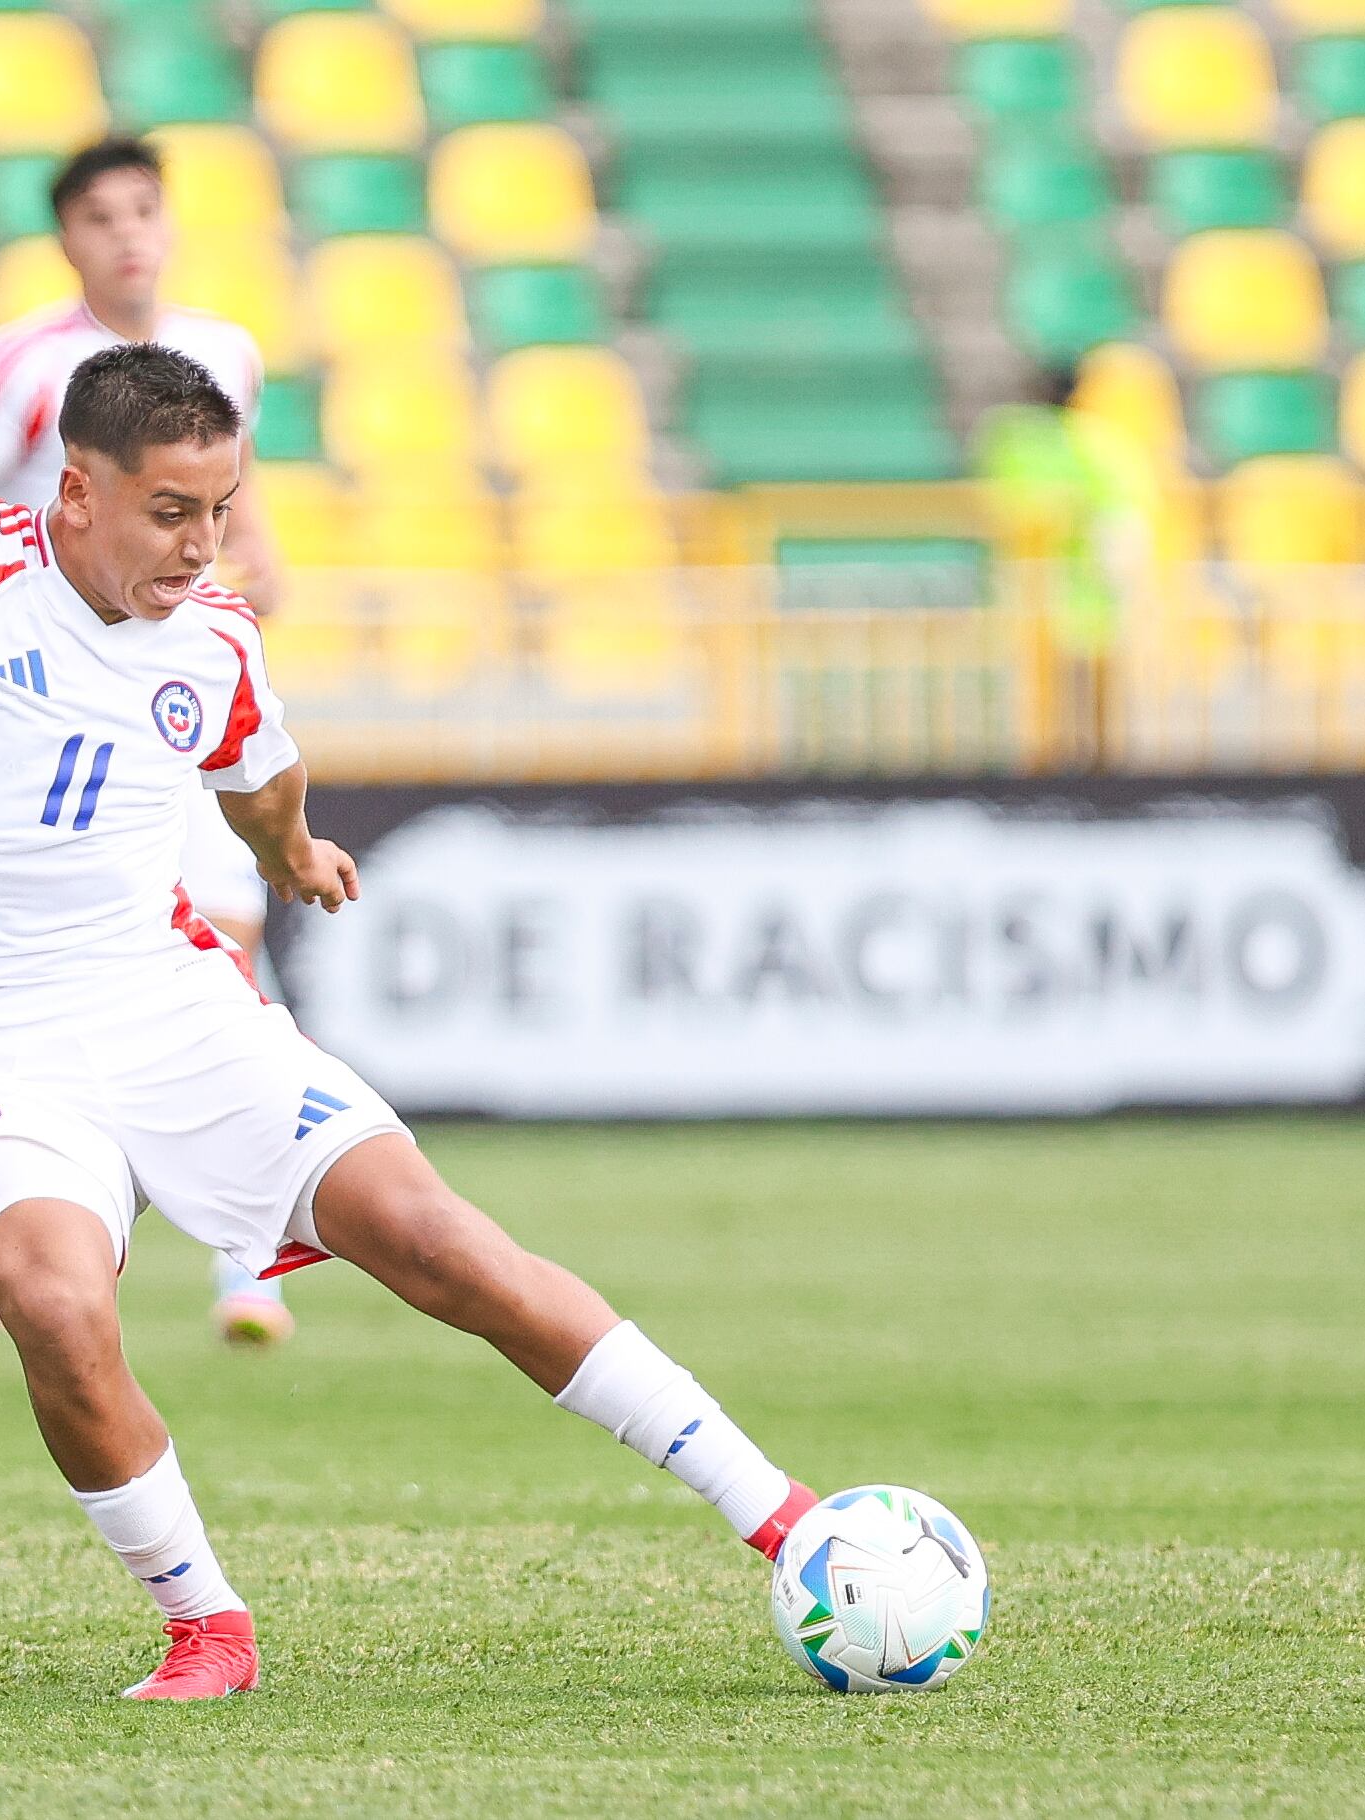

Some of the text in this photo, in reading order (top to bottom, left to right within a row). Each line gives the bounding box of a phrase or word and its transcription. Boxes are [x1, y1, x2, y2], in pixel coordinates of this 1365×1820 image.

[39, 732, 115, 831] 11
[371, 893, 566, 1022] DE
[628, 886, 1330, 1018] RACISMO
